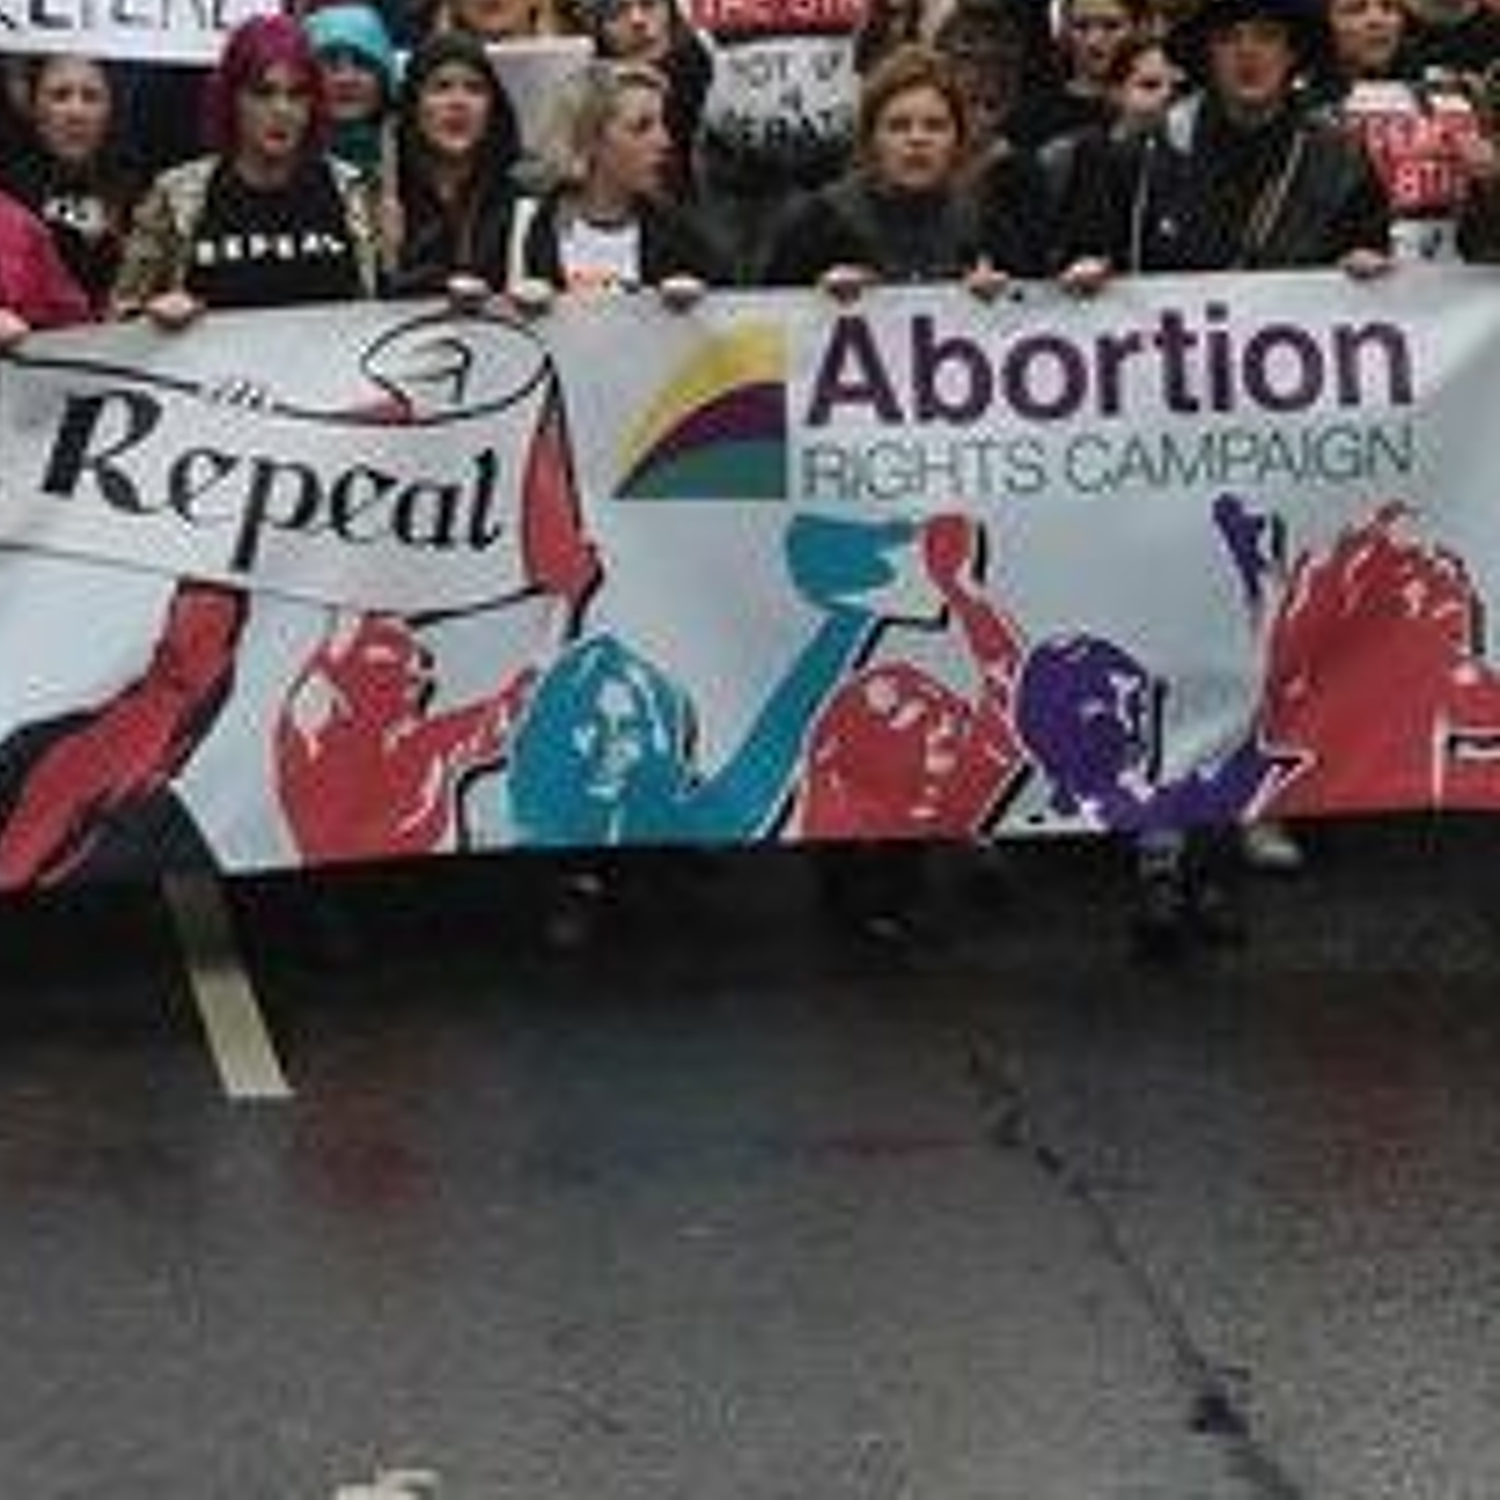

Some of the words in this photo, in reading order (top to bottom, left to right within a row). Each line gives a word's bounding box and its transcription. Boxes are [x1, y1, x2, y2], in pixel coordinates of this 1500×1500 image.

[806, 303, 1414, 427] Abortion
[41, 388, 502, 572] Repeal
[802, 437, 1047, 499] RIGHTS
[1064, 424, 1414, 494] CAMPAIGN
